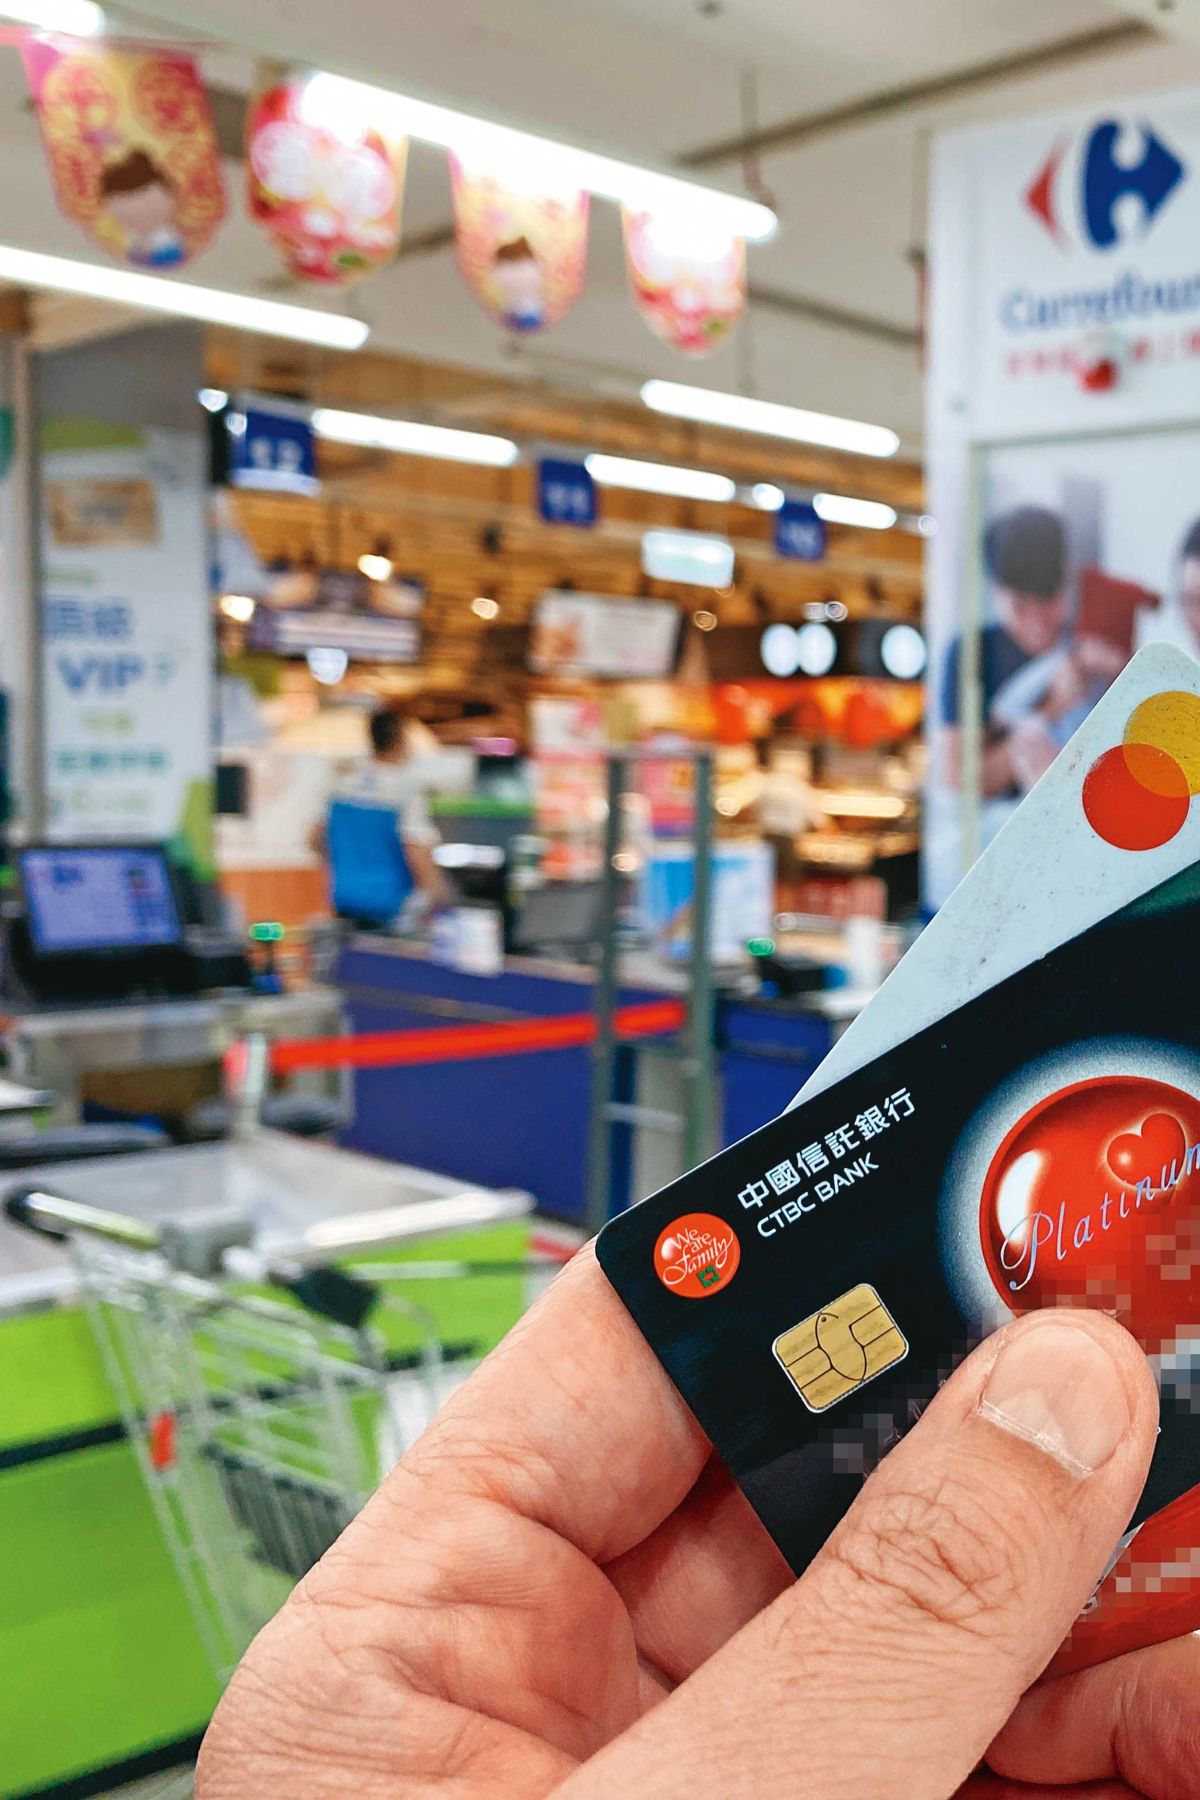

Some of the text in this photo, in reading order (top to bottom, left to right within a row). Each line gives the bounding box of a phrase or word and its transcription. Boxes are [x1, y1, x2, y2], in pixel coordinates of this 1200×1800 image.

[737, 1087, 916, 1211] 中國信託銀行
[757, 1152, 880, 1239] CTBC BANK
[671, 1227, 699, 1250] We
[690, 1232, 711, 1254] are
